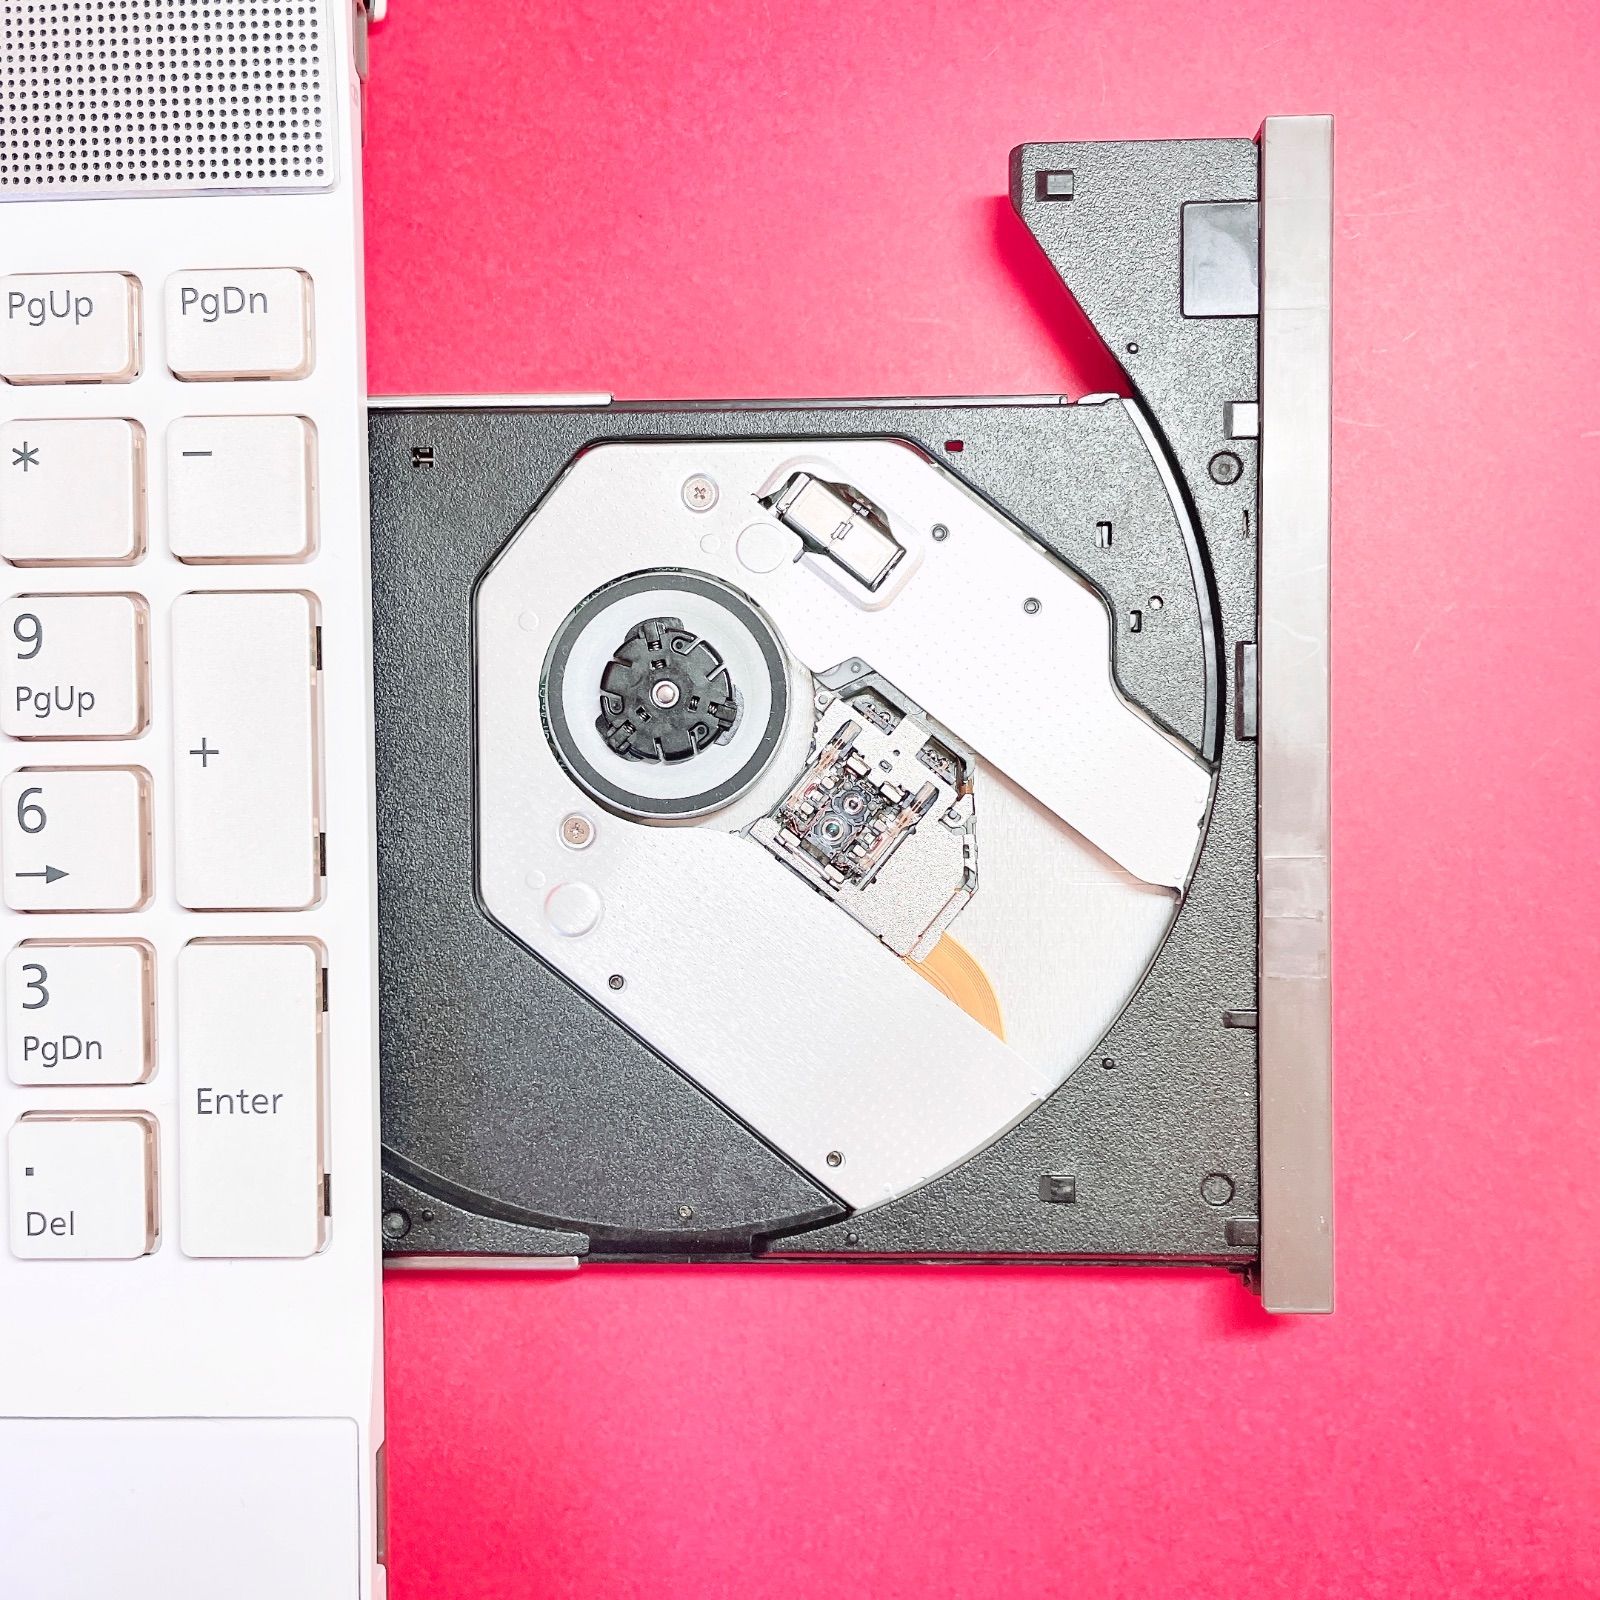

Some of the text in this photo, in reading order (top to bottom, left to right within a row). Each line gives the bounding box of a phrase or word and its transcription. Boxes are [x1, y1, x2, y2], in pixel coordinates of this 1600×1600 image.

[9, 290, 94, 326] PgUp
[181, 286, 268, 322] PgDn
[13, 613, 43, 660] 9
[16, 685, 95, 718] PgUp
[17, 787, 47, 834] 6
[22, 963, 50, 1010] 3
[23, 1035, 103, 1068] PgDn
[197, 1087, 283, 1115] Enter
[26, 1210, 75, 1236] Del
